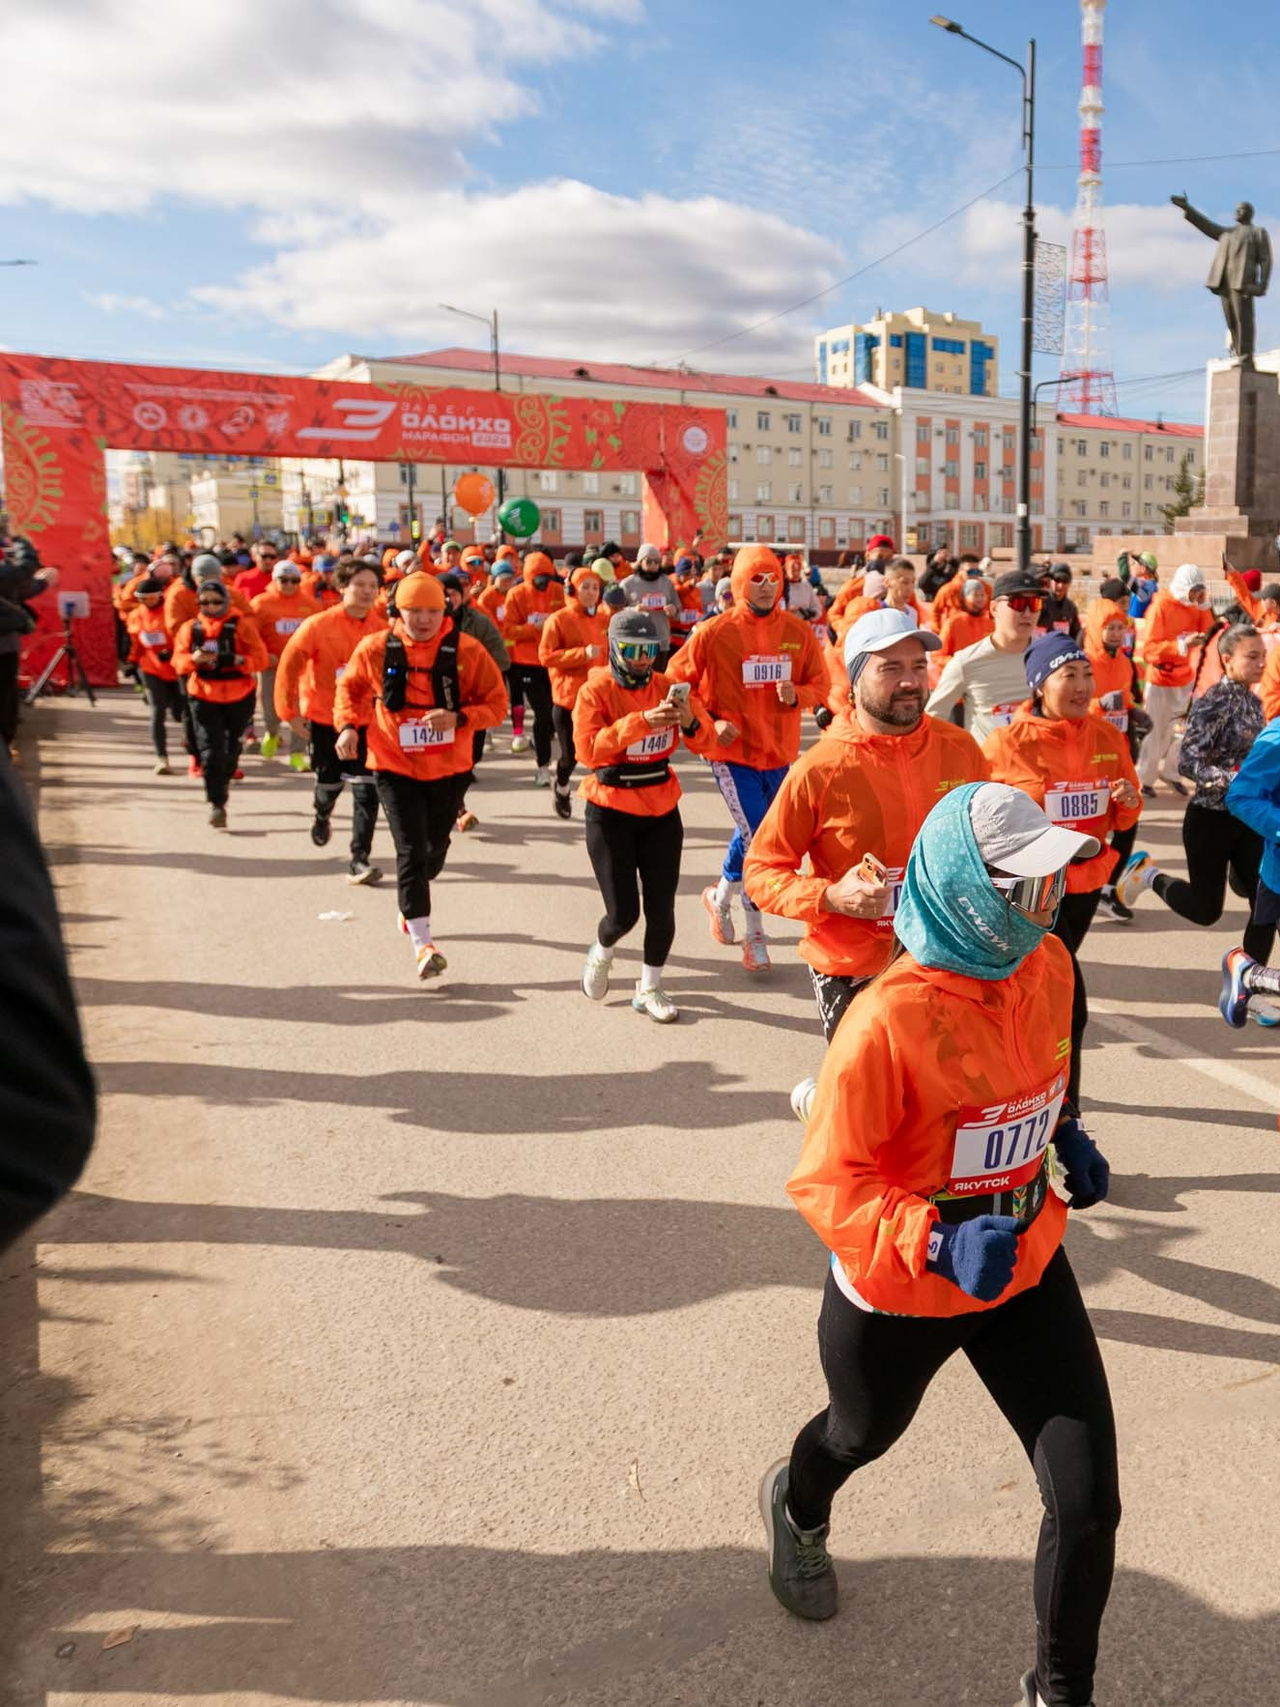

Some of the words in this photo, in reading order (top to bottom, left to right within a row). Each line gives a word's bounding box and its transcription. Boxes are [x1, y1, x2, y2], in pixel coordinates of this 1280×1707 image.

[402, 412, 511, 433] ОЛОНХО
[1061, 792, 1099, 818] 0885
[984, 1108, 1050, 1170] 0772
[954, 1175, 1010, 1191] ЯКУТСК
